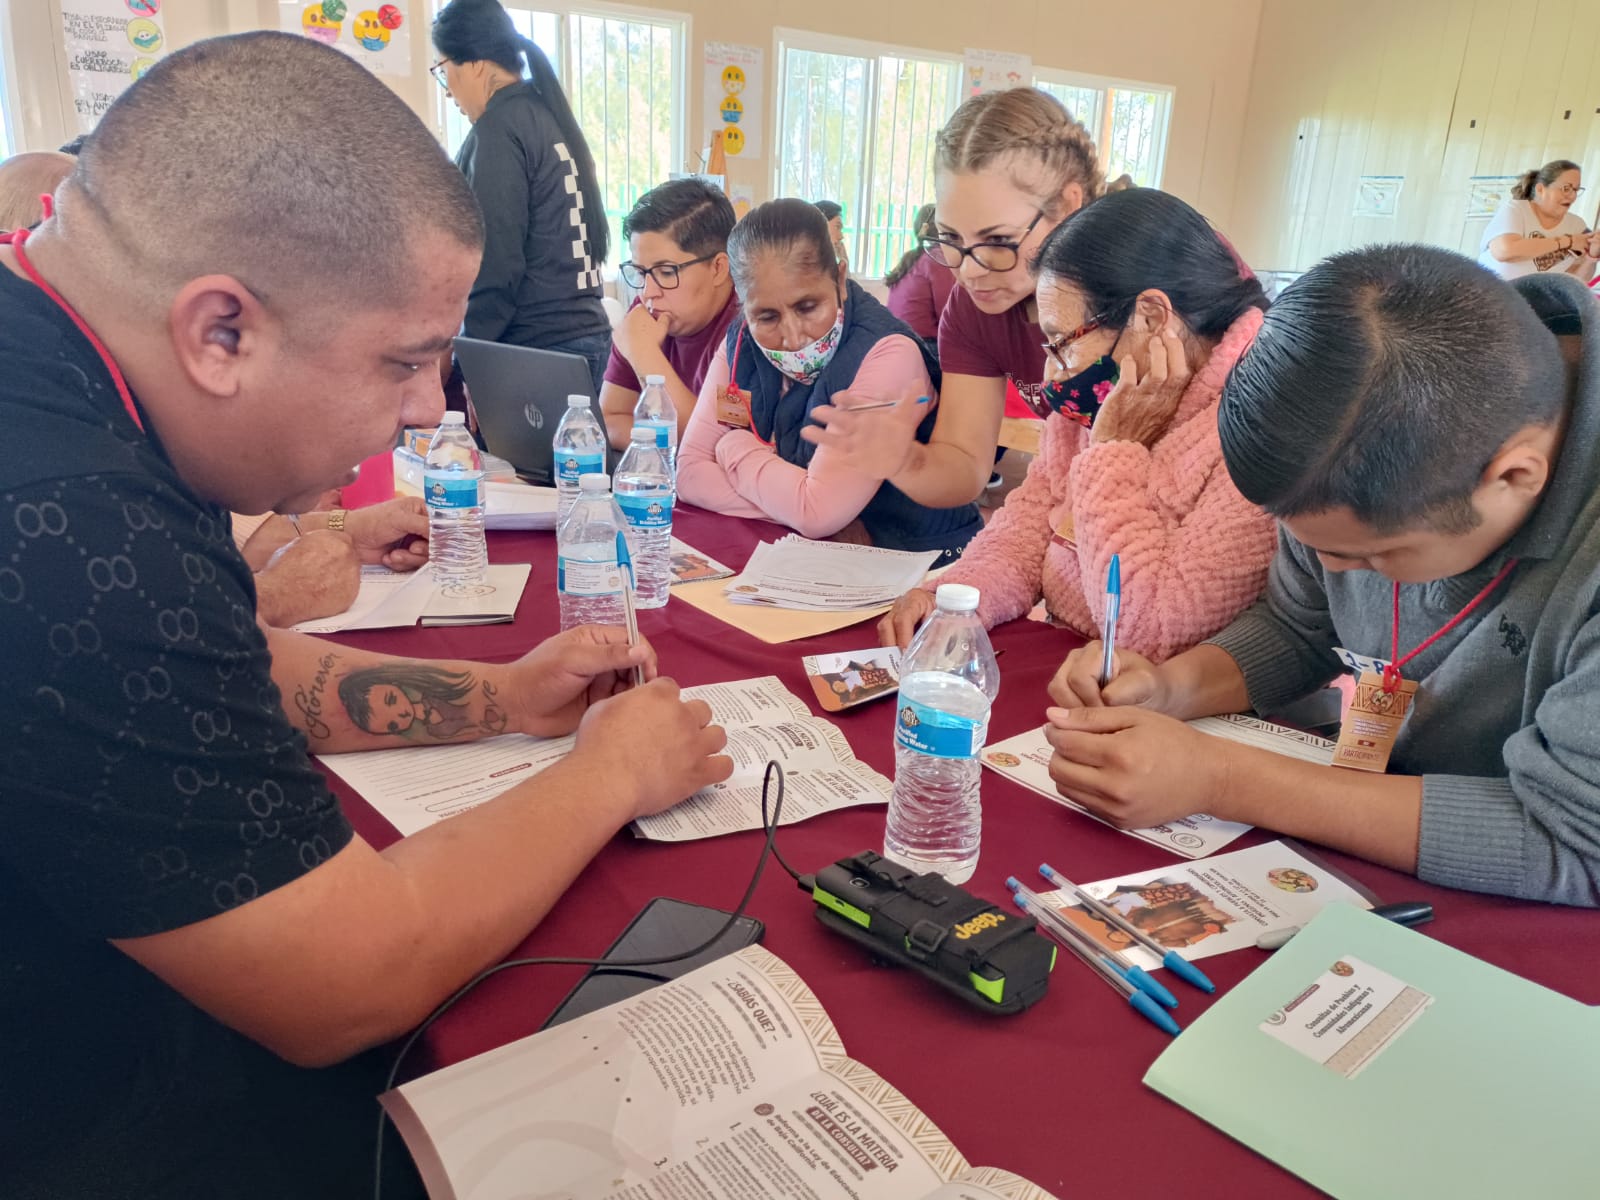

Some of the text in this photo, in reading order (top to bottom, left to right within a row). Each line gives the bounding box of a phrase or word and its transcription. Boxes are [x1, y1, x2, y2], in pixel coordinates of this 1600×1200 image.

[524, 403, 544, 430] hp
[295, 652, 343, 740] Forever
[909, 738, 928, 750] Water
[727, 979, 759, 1010] ¿SABÍAS
[1304, 1007, 1332, 1030] Consultas
[1329, 1002, 1337, 1010] de
[1334, 986, 1355, 1005] Pueblos
[1335, 1001, 1372, 1034] Afromexicanas
[695, 1004, 727, 1044] Comunidades
[713, 1013, 736, 1040] derecho
[730, 1039, 743, 1055] que
[740, 1054, 756, 1082] tienen
[1312, 1009, 1347, 1039] Comunidades
[635, 1039, 645, 1050] sus
[642, 1049, 670, 1091] propuestas.
[650, 1044, 661, 1056] con
[663, 1064, 686, 1106] contenido,
[665, 1021, 685, 1044] puedan
[683, 1044, 701, 1068] afectar
[697, 1069, 706, 1080] su
[703, 1080, 713, 1101] vida,
[668, 1053, 676, 1064] no
[673, 1063, 685, 1079] una
[682, 1078, 692, 1096] Ley,
[675, 1048, 697, 1083] Consultar
[695, 1084, 702, 1095] es
[676, 1021, 694, 1041] cuenta
[691, 1041, 710, 1068] cuando
[708, 1068, 717, 1083] hay
[687, 1022, 708, 1047] pueblos
[705, 1047, 721, 1071] deben
[719, 1072, 728, 1085] ser
[713, 1043, 725, 1059] Este
[722, 1060, 742, 1095] derecho
[729, 1120, 741, 1131] 1.
[766, 1117, 817, 1170] de Baja California.
[773, 1113, 800, 1139] Reforma
[808, 1148, 823, 1162] Ley
[819, 1159, 832, 1171] de
[809, 1089, 899, 1173] ¿CUÁL ES LA MATERIA
[810, 1107, 871, 1166] DE LA CONSULTA?
